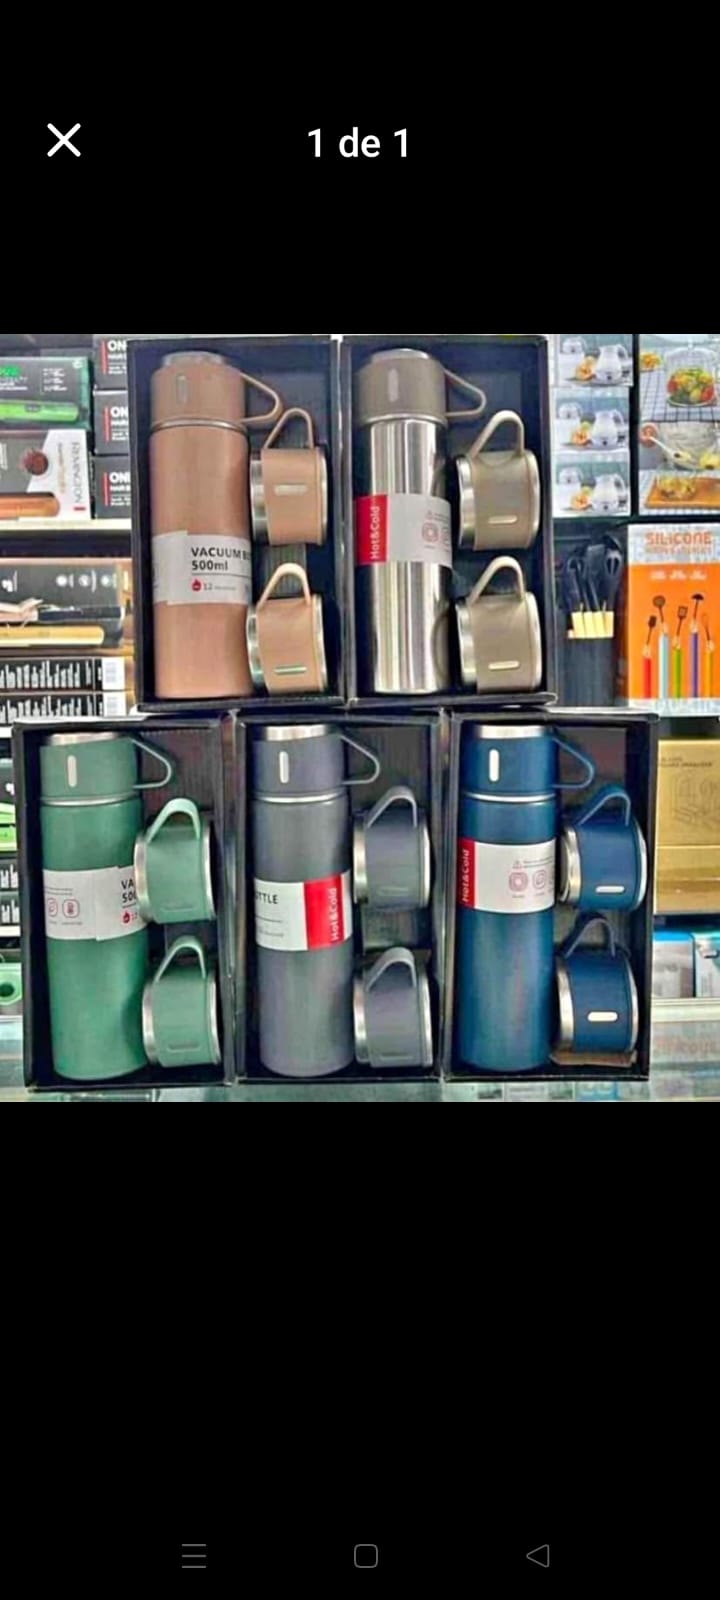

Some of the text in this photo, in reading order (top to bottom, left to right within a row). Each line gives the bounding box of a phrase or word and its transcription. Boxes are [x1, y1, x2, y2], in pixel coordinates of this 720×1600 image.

[369, 505, 380, 560] Hot&Cold
[191, 547, 241, 558] VACUUM
[191, 560, 228, 571] 500ml
[328, 887, 340, 942] Hot&Cold
